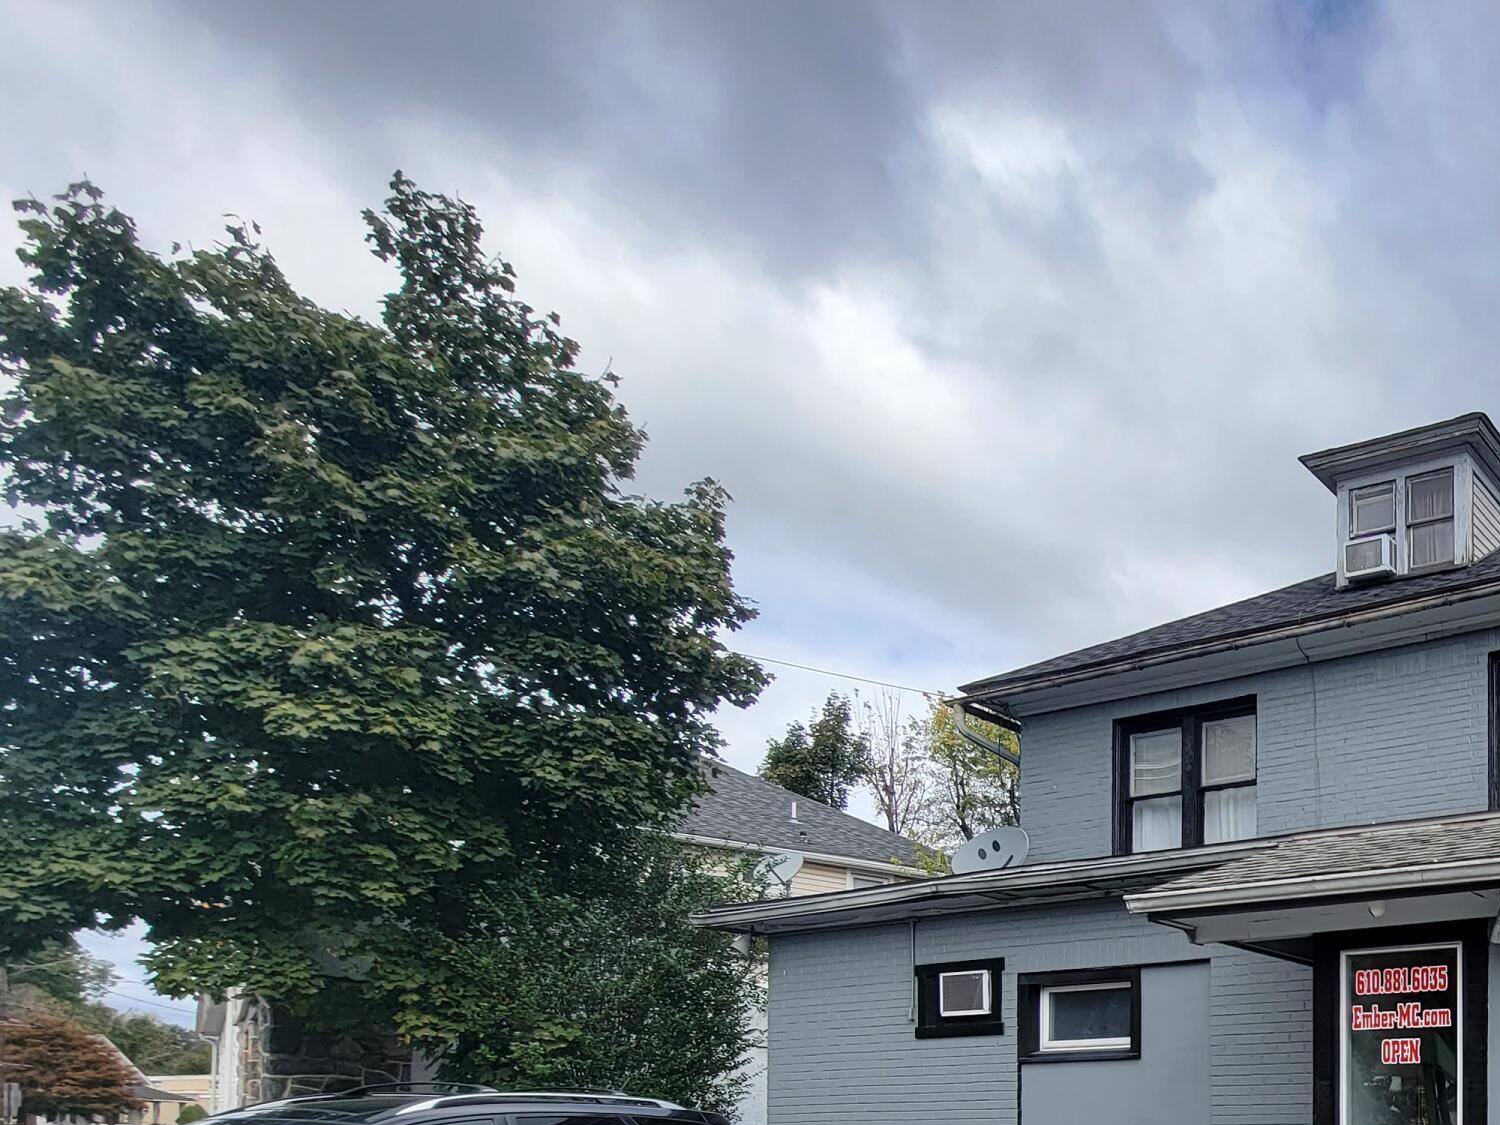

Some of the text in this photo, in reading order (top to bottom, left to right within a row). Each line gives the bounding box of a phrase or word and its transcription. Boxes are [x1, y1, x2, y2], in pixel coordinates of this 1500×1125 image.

[1356, 965, 1448, 995] 610.881.6035
[1352, 1002, 1452, 1030] Ember-MC.com
[1381, 1038, 1421, 1064] OPEN
